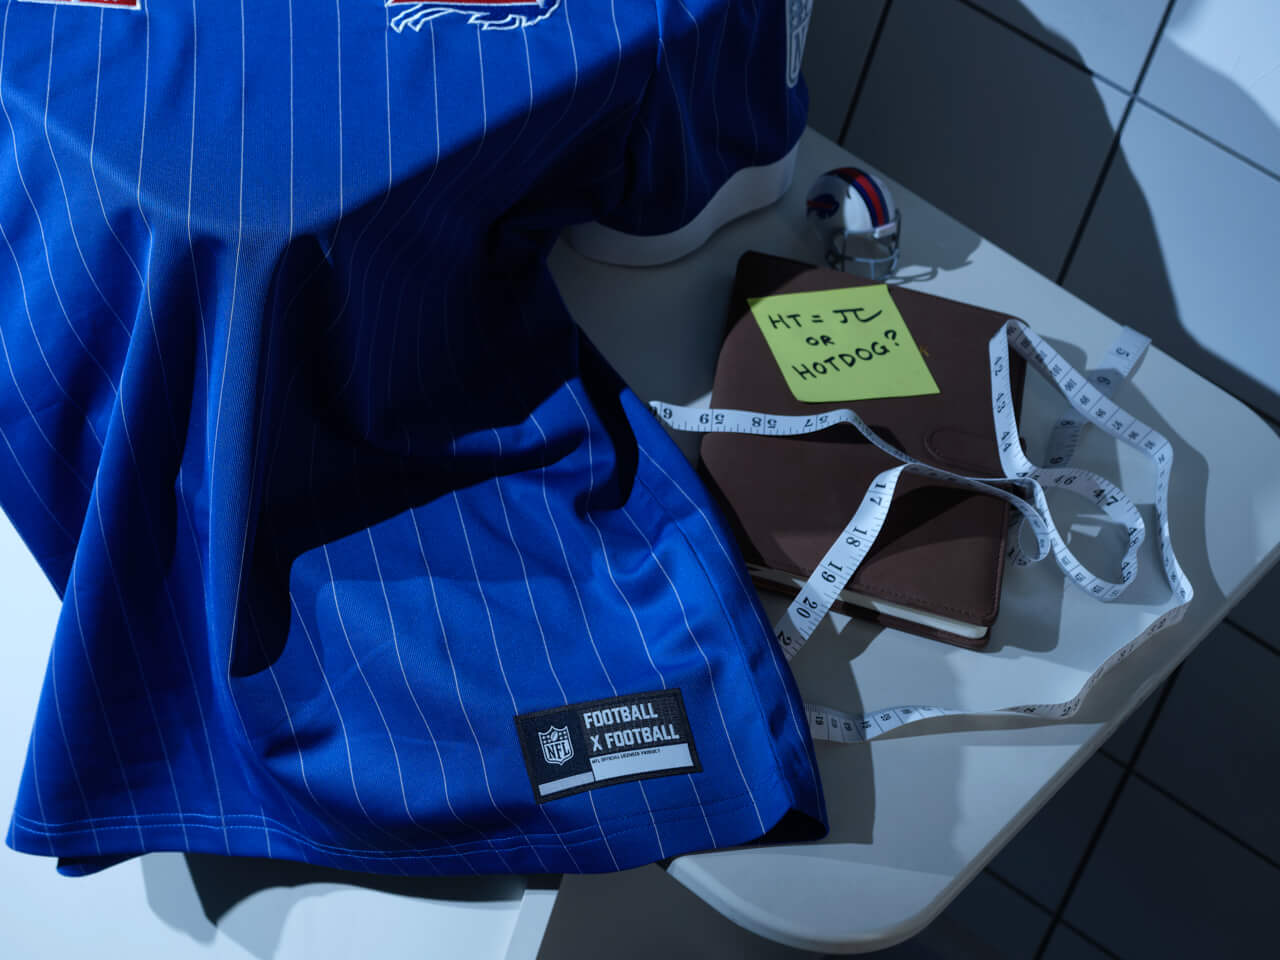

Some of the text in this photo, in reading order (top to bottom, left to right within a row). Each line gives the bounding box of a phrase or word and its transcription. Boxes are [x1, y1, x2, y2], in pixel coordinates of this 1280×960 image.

[768, 313, 802, 329] HT
[805, 334, 835, 346] OR
[792, 329, 899, 381] HOTDOG?
[869, 482, 886, 507] 17
[846, 526, 868, 548] 18
[821, 561, 843, 584] 19
[796, 596, 818, 619] 20
[583, 702, 659, 729] FOOTBALL
[590, 723, 681, 752] X FOOTBALL
[545, 741, 572, 760] NFL
